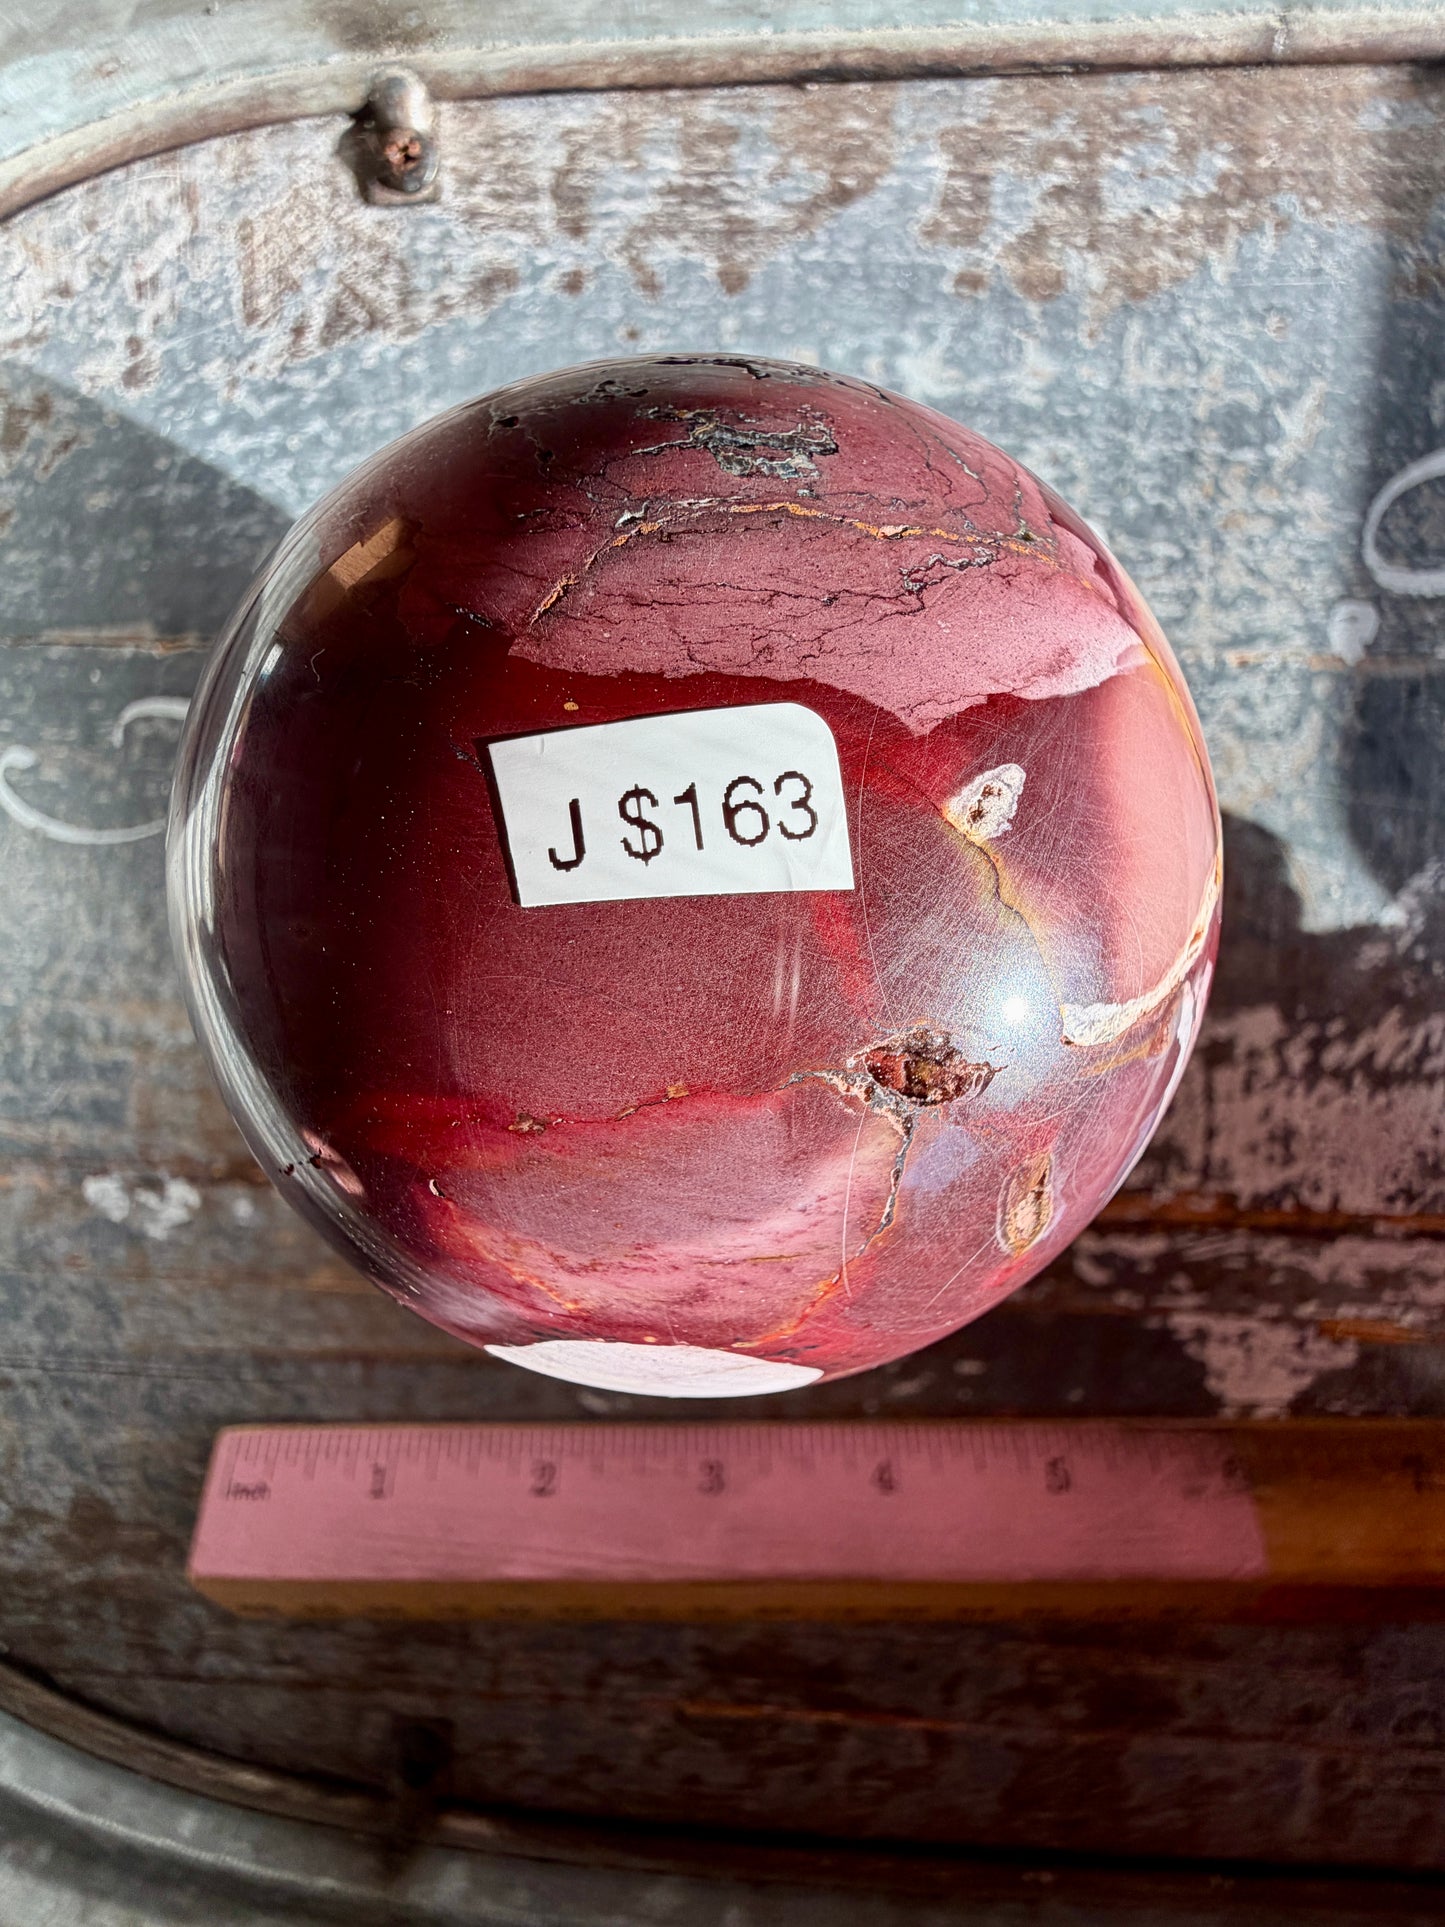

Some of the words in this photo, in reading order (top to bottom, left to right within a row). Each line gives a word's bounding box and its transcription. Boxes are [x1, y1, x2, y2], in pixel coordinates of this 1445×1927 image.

[548, 798, 586, 872] J
[618, 770, 819, 867] $163
[370, 1461, 386, 1499] 1
[531, 1458, 557, 1497] 2
[700, 1458, 726, 1496] 3
[872, 1458, 897, 1496] 4
[1044, 1455, 1071, 1495] 5
